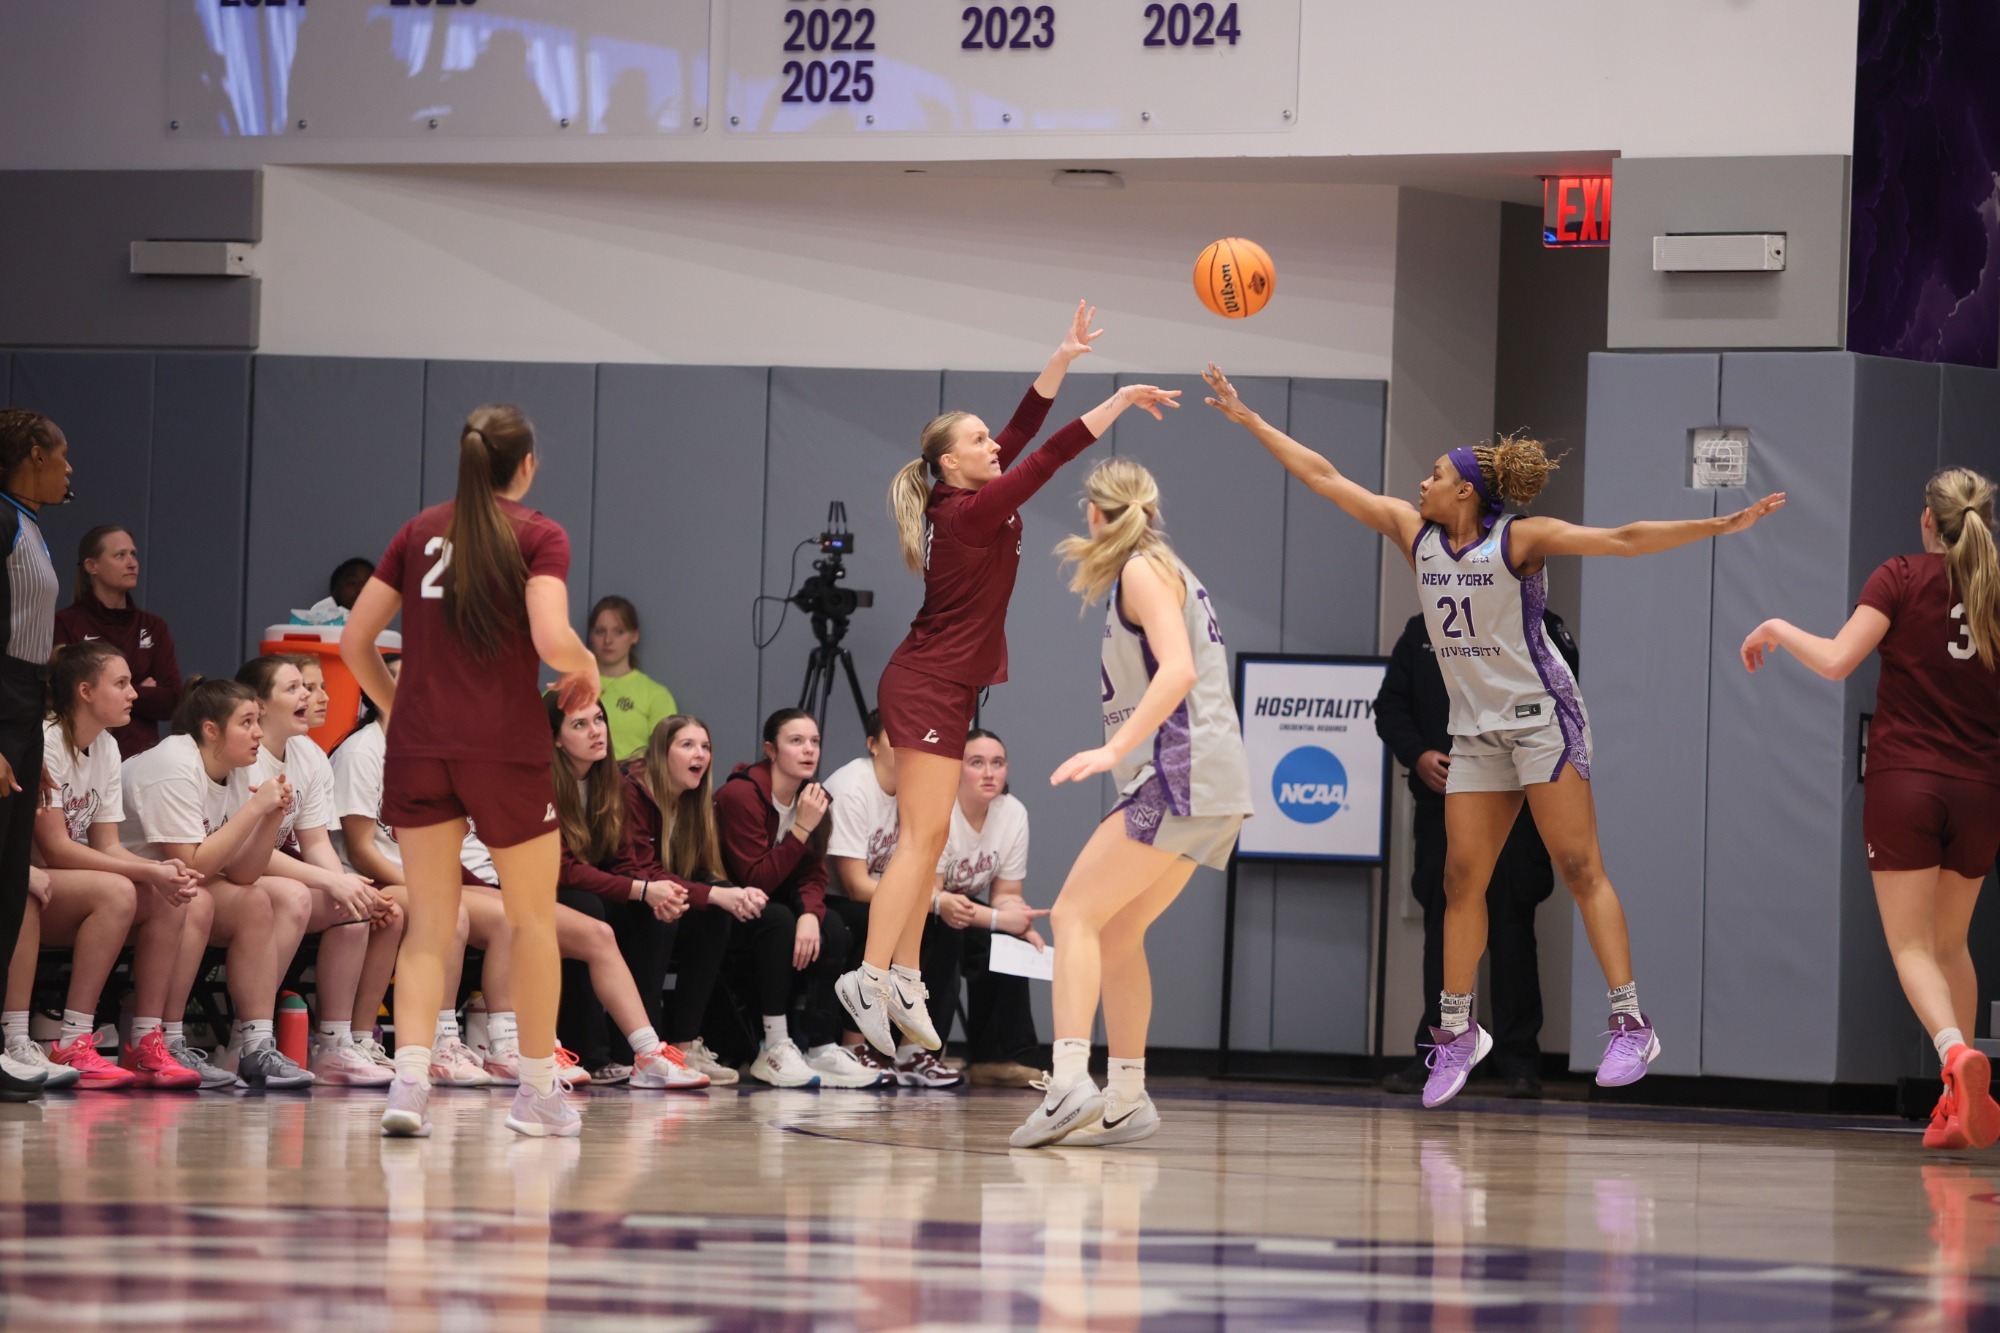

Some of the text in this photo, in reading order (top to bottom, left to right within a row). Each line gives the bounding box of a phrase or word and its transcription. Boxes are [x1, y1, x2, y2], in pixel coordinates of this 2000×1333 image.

[783, 9, 876, 51] 2022
[961, 6, 1055, 49] 2023
[1143, 3, 1241, 46] 2024
[781, 60, 874, 102] 2025
[1557, 178, 1612, 241] EXI
[1221, 263, 1240, 313] Wilson
[1421, 572, 1494, 587] NEW YORK
[1437, 596, 1476, 638] 21
[1254, 696, 1374, 719] HOSPITALITY
[1279, 783, 1345, 805] NCAA
